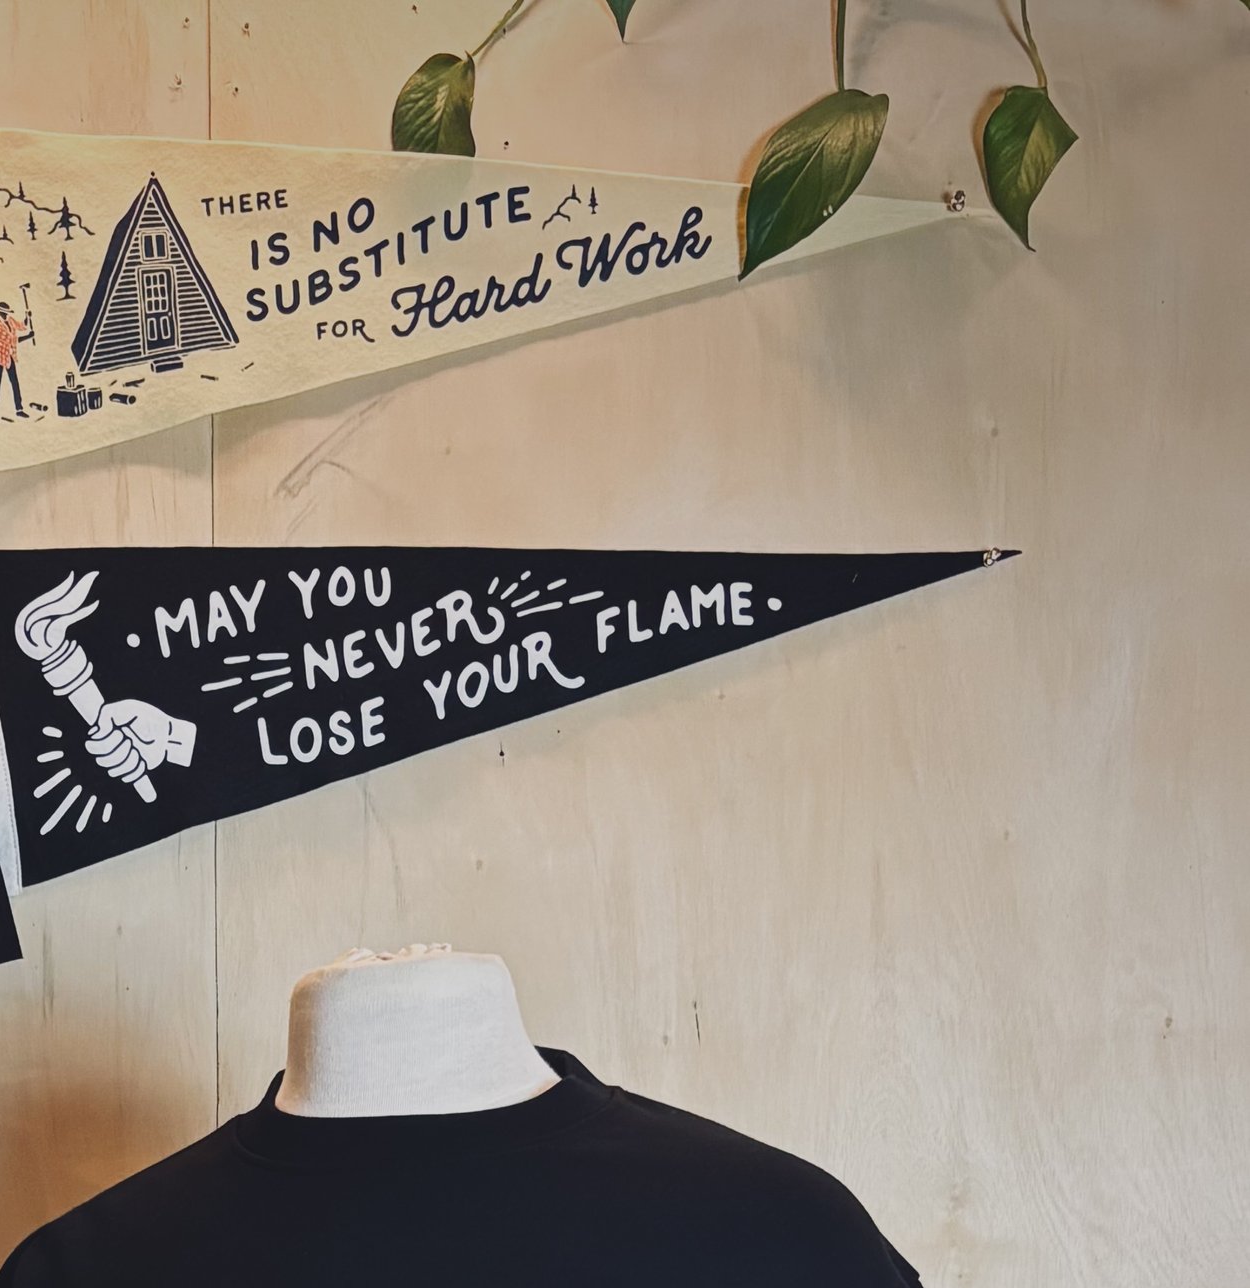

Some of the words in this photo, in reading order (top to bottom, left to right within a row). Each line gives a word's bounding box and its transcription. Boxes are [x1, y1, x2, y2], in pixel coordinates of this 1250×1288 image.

[201, 189, 288, 216] THERE
[250, 232, 290, 270] IS
[312, 198, 374, 252] NO
[245, 186, 531, 322] SUBSTITUTE
[316, 318, 375, 343] FOR
[391, 252, 552, 337] Hard
[555, 205, 712, 288] Work
[154, 579, 267, 658] MAY
[288, 566, 392, 621] YOU
[303, 589, 506, 690] NEVER
[257, 697, 386, 766] LOSE
[423, 631, 586, 720] YOUR
[596, 581, 754, 653] FLAME
